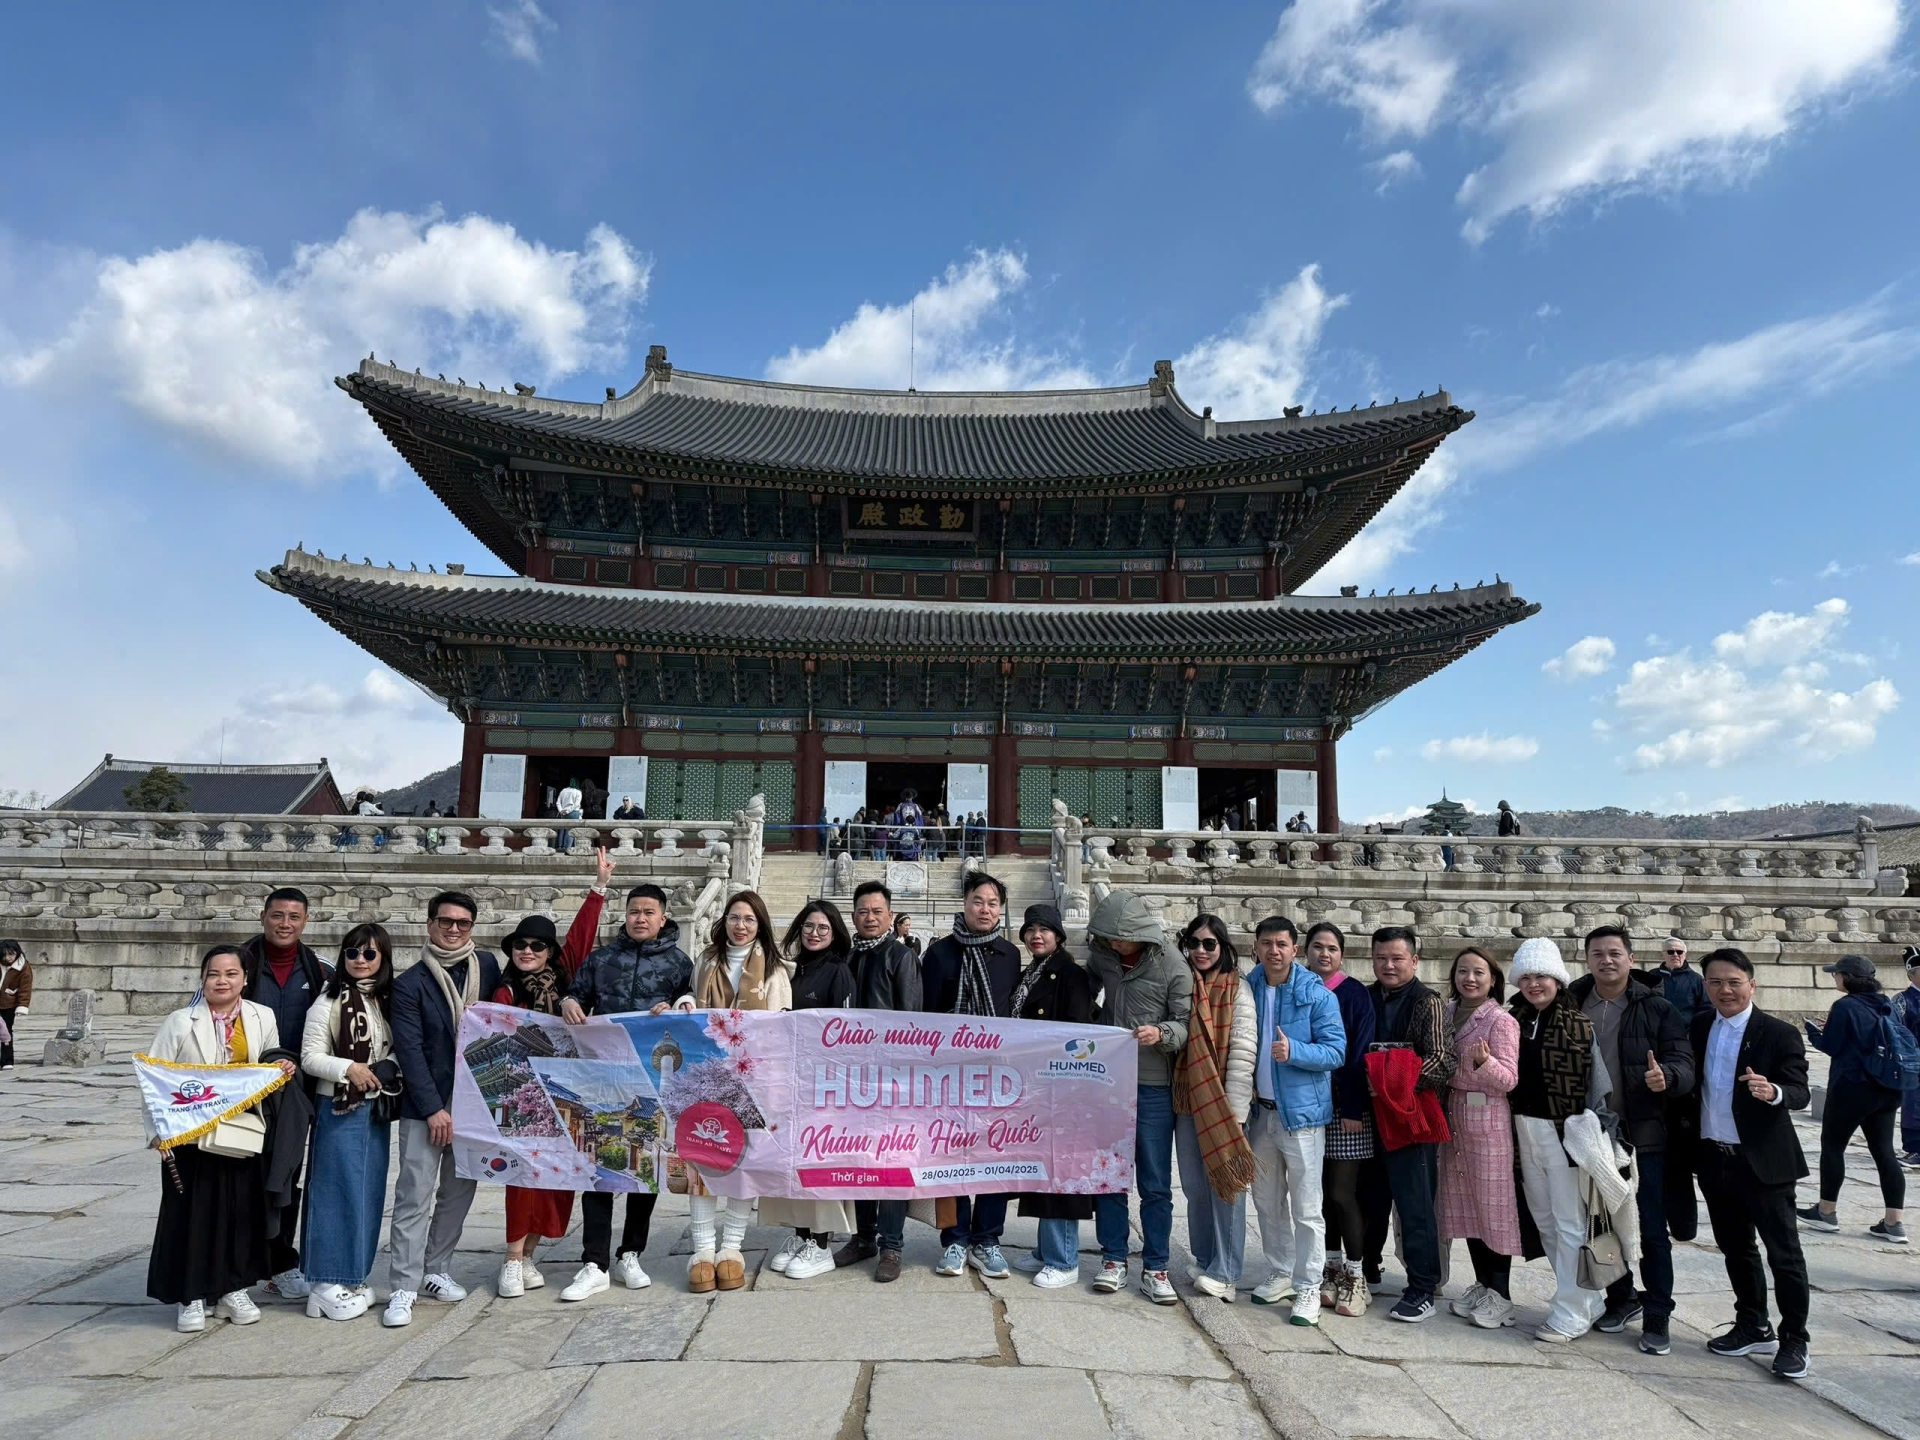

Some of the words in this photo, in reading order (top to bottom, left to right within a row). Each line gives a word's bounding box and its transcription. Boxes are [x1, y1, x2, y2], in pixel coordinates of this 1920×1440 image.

[821, 1017, 878, 1048] Chào
[884, 1022, 946, 1056] mừng
[951, 1023, 1004, 1050] đoàn
[1049, 1061, 1106, 1073] HUNMED
[814, 1063, 1023, 1109] HUNMED
[204, 1098, 229, 1108] TRAVEL
[686, 1136, 703, 1145] TRANG
[713, 1143, 732, 1153] TRAVEL
[800, 1124, 871, 1161] Khám
[876, 1124, 919, 1160] phá
[927, 1118, 980, 1154] Hàn
[987, 1115, 1043, 1152] Quốc
[830, 1171, 854, 1183] Thời
[857, 1173, 880, 1184] gian
[921, 1167, 976, 1181] 28/03/2025
[984, 1165, 1039, 1176] 01/04/2025
